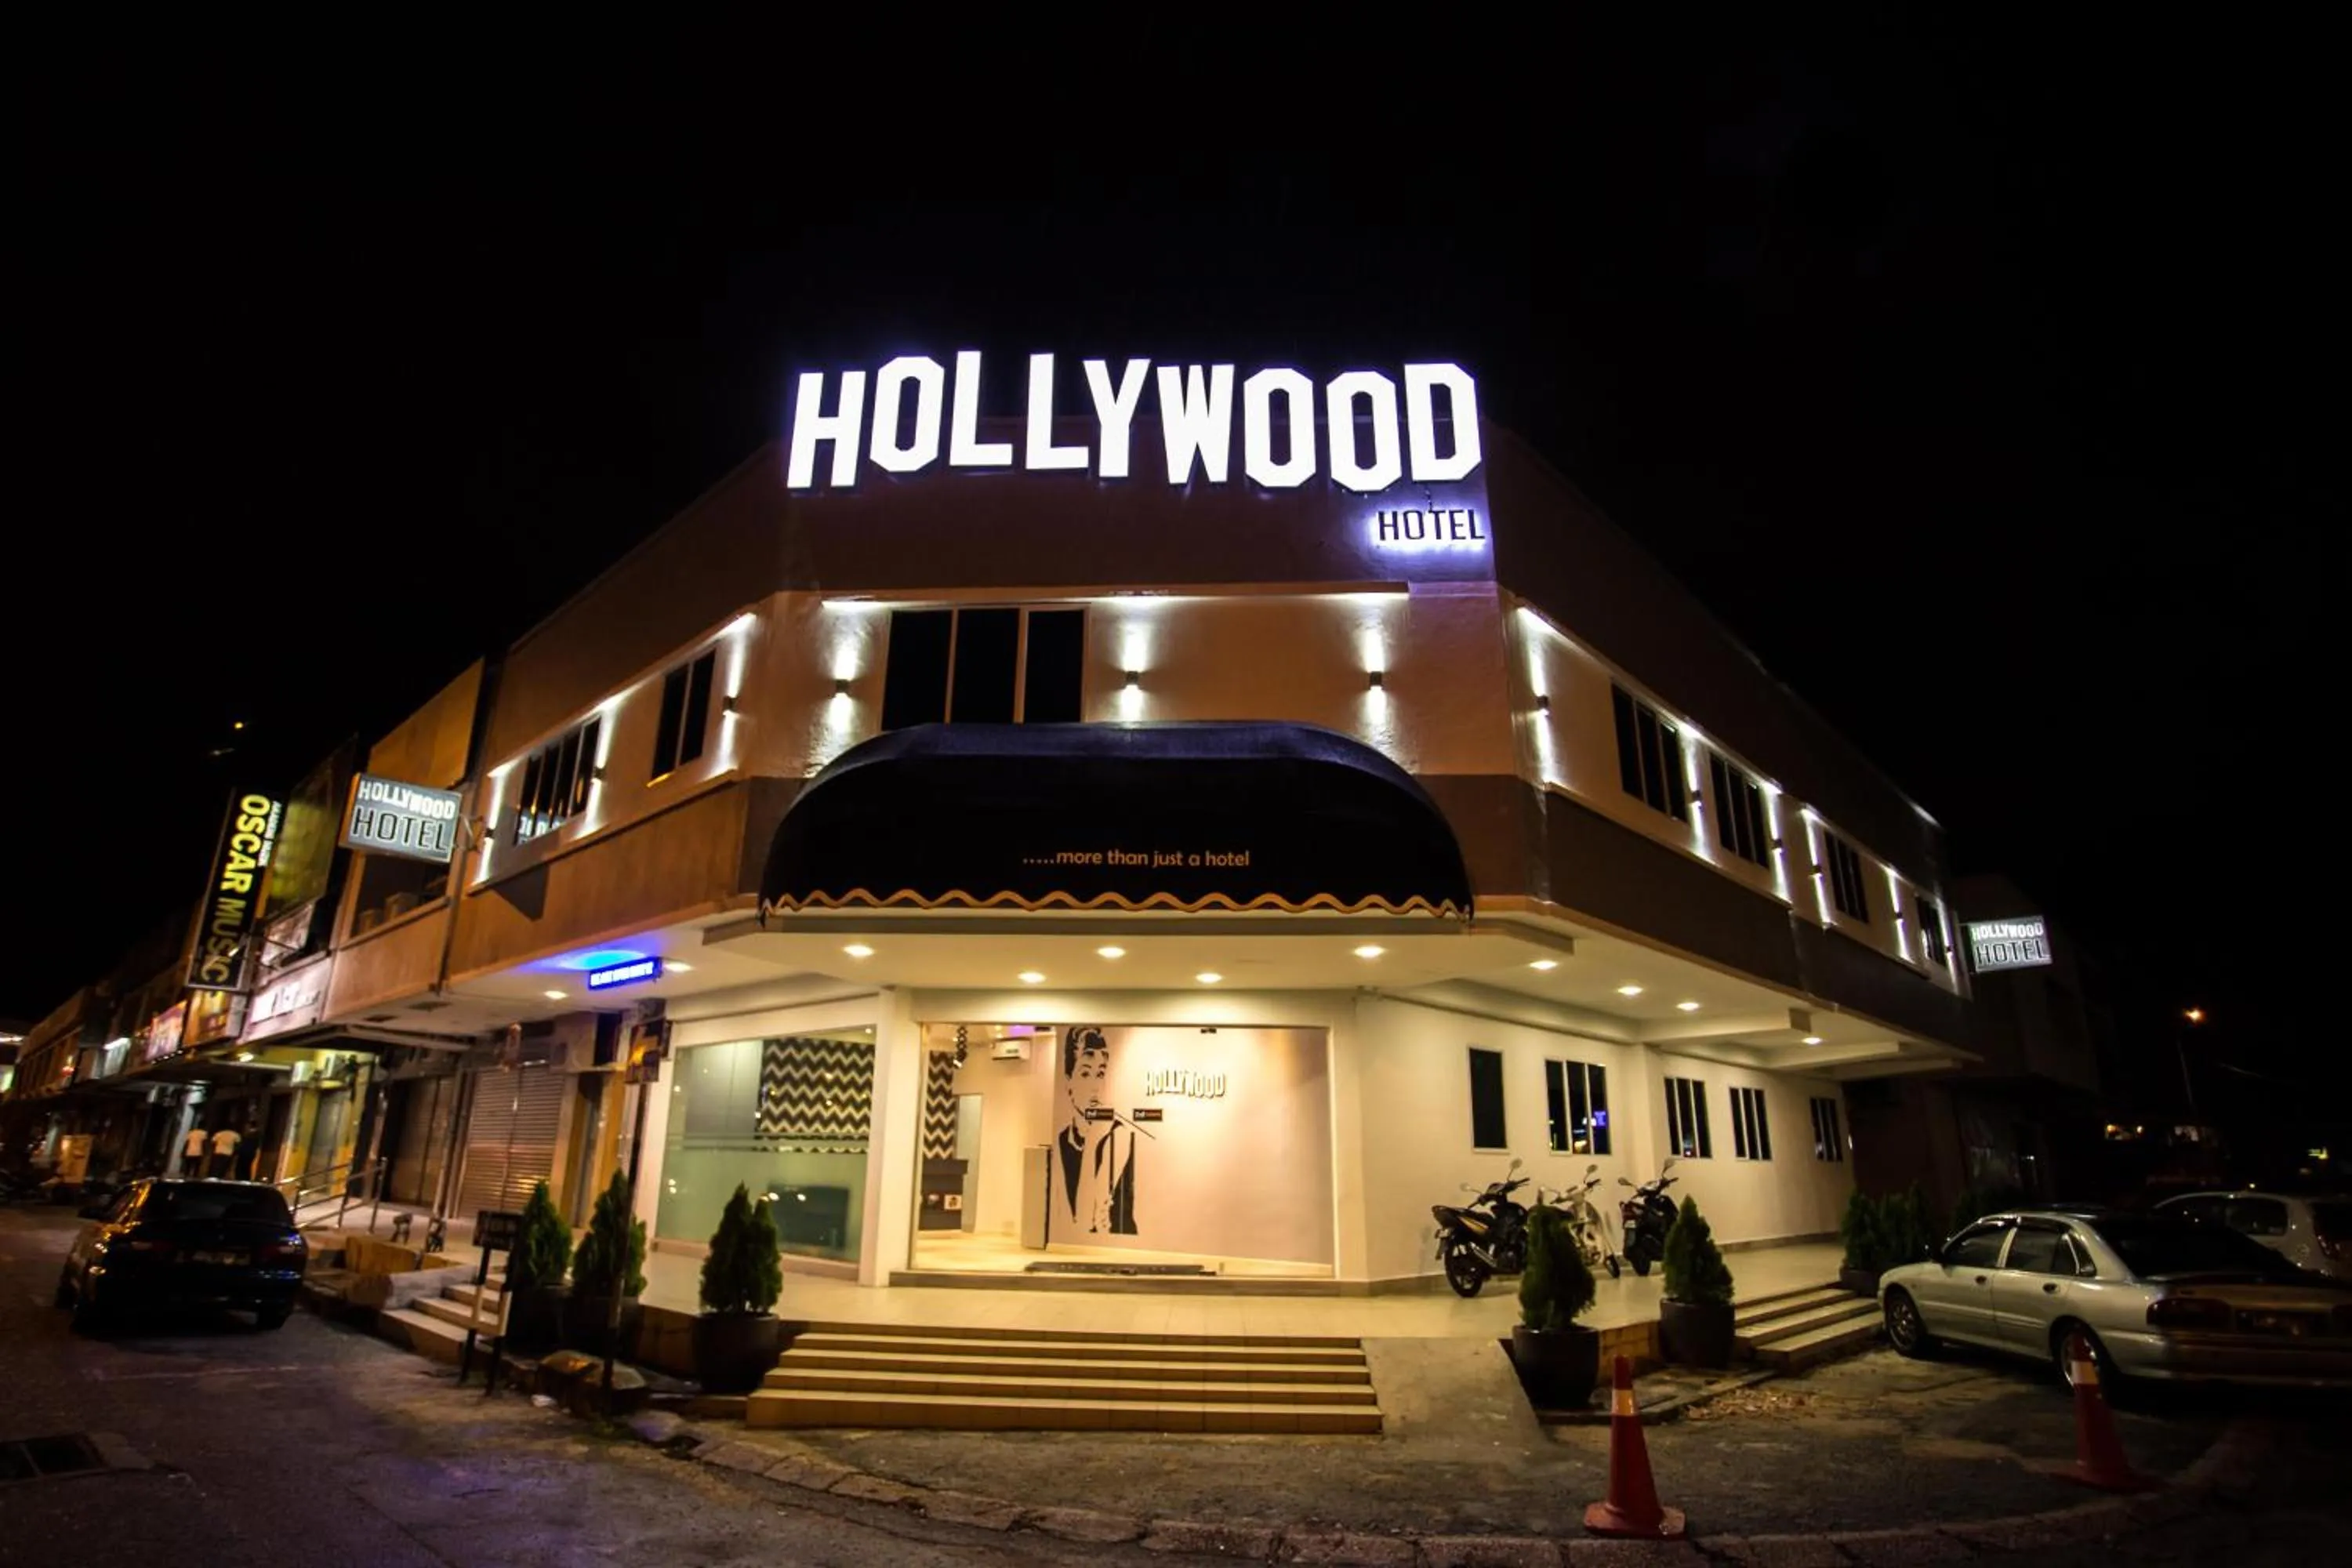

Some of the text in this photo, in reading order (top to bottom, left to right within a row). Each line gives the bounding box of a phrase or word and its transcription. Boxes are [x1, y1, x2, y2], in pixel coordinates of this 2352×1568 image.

[786, 350, 1482, 492] HOLLYWOOD
[1377, 509, 1486, 541] HOTEL
[358, 780, 456, 821] HOLLYWOOD
[220, 794, 270, 895] OSCAR
[352, 806, 448, 852] HOTEL
[1107, 849, 1149, 866] than
[1152, 850, 1183, 869] just
[1189, 853, 1200, 866] a
[1206, 850, 1250, 866] hotel
[201, 897, 247, 983] MUSIC
[1971, 922, 2045, 942] HOLLYWOOD
[1976, 939, 2051, 965] HOTEL
[1145, 1069, 1226, 1099] HOLLYWOOD
